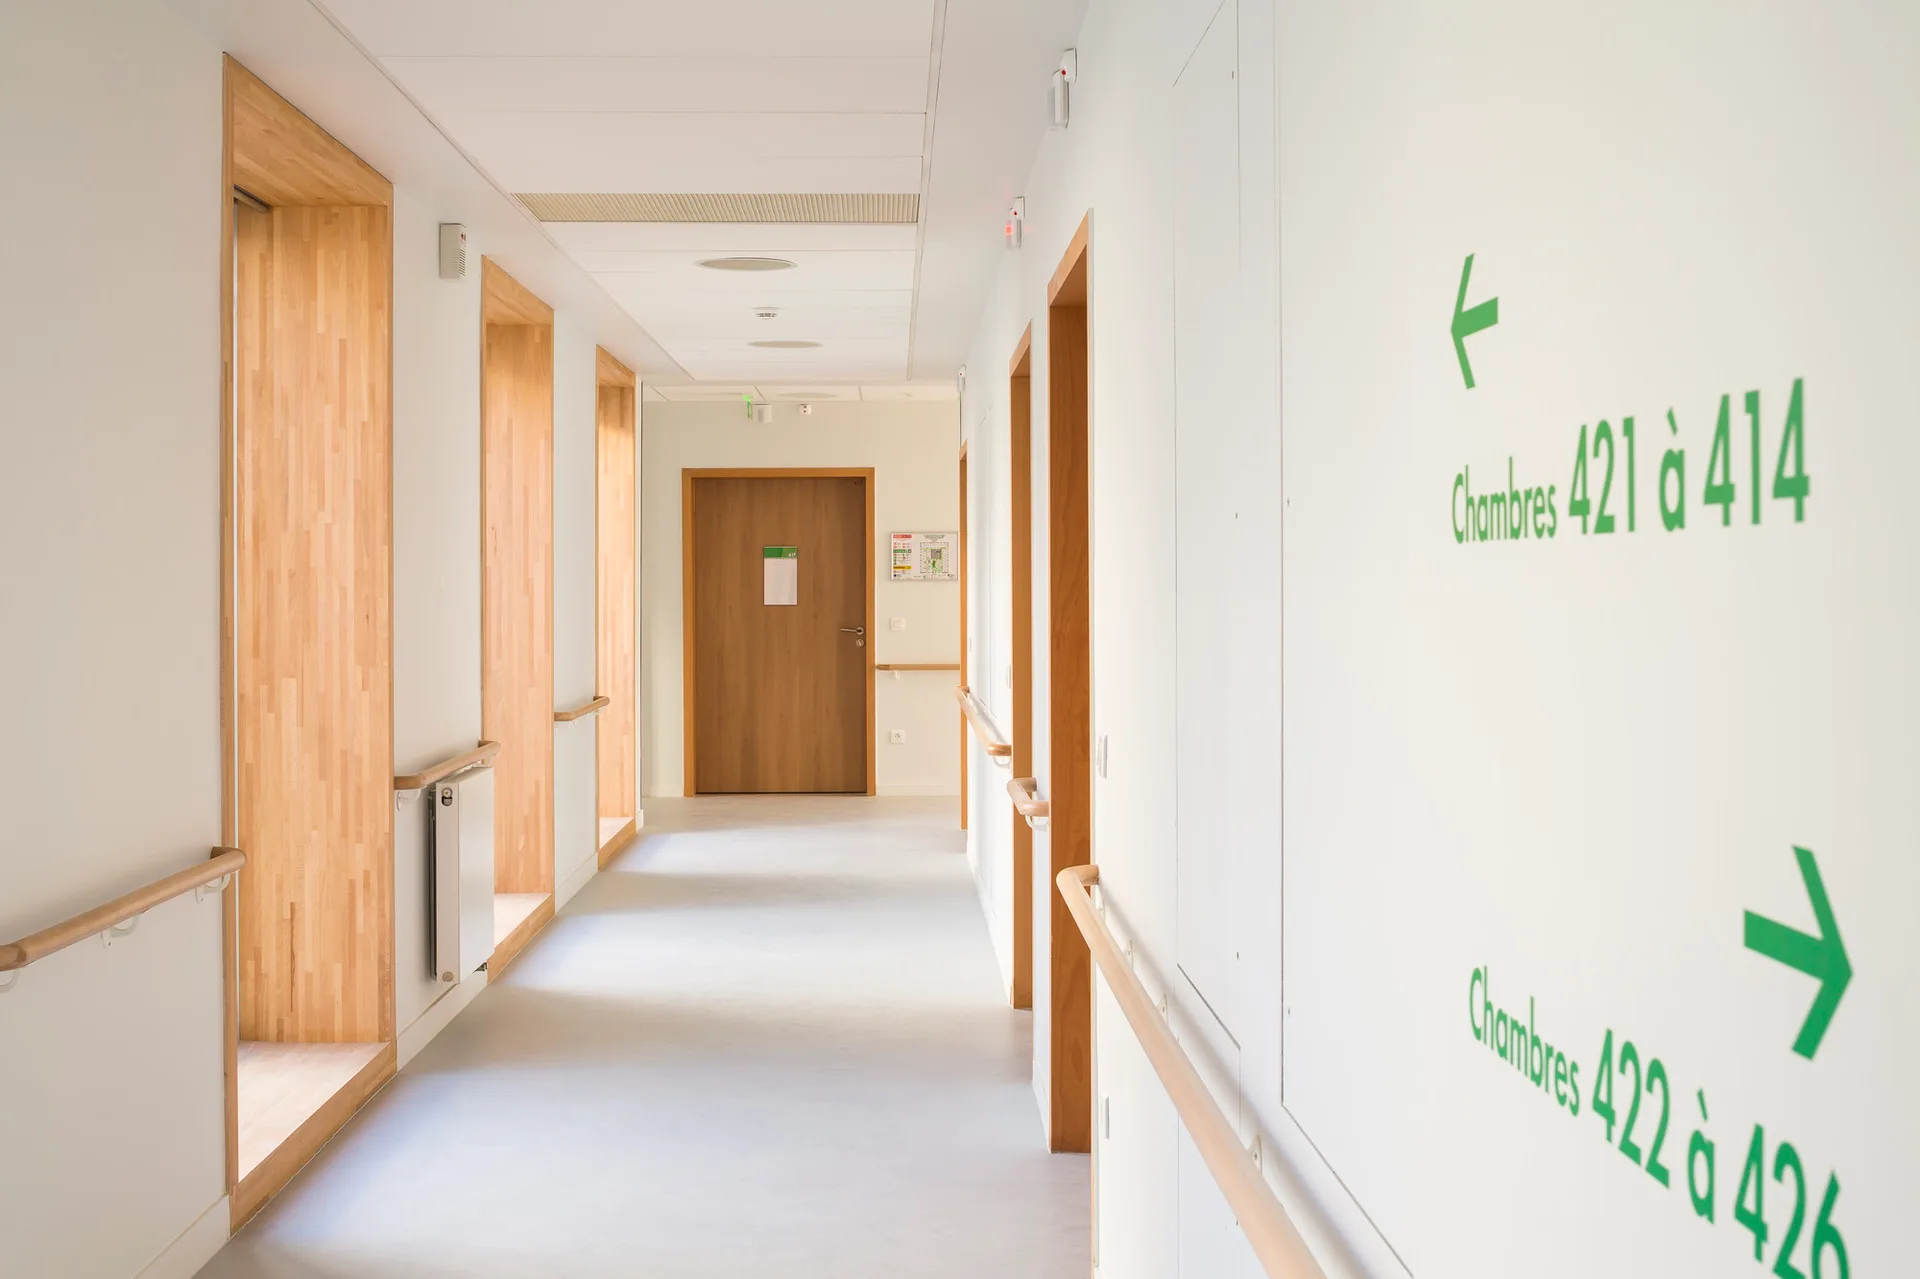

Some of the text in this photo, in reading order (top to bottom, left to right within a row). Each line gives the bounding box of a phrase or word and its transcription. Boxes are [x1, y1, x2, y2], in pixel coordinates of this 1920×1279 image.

[1452, 378, 1810, 544] Chambres 421 à 414
[1469, 966, 1850, 1279] Chambres 422 à 426
